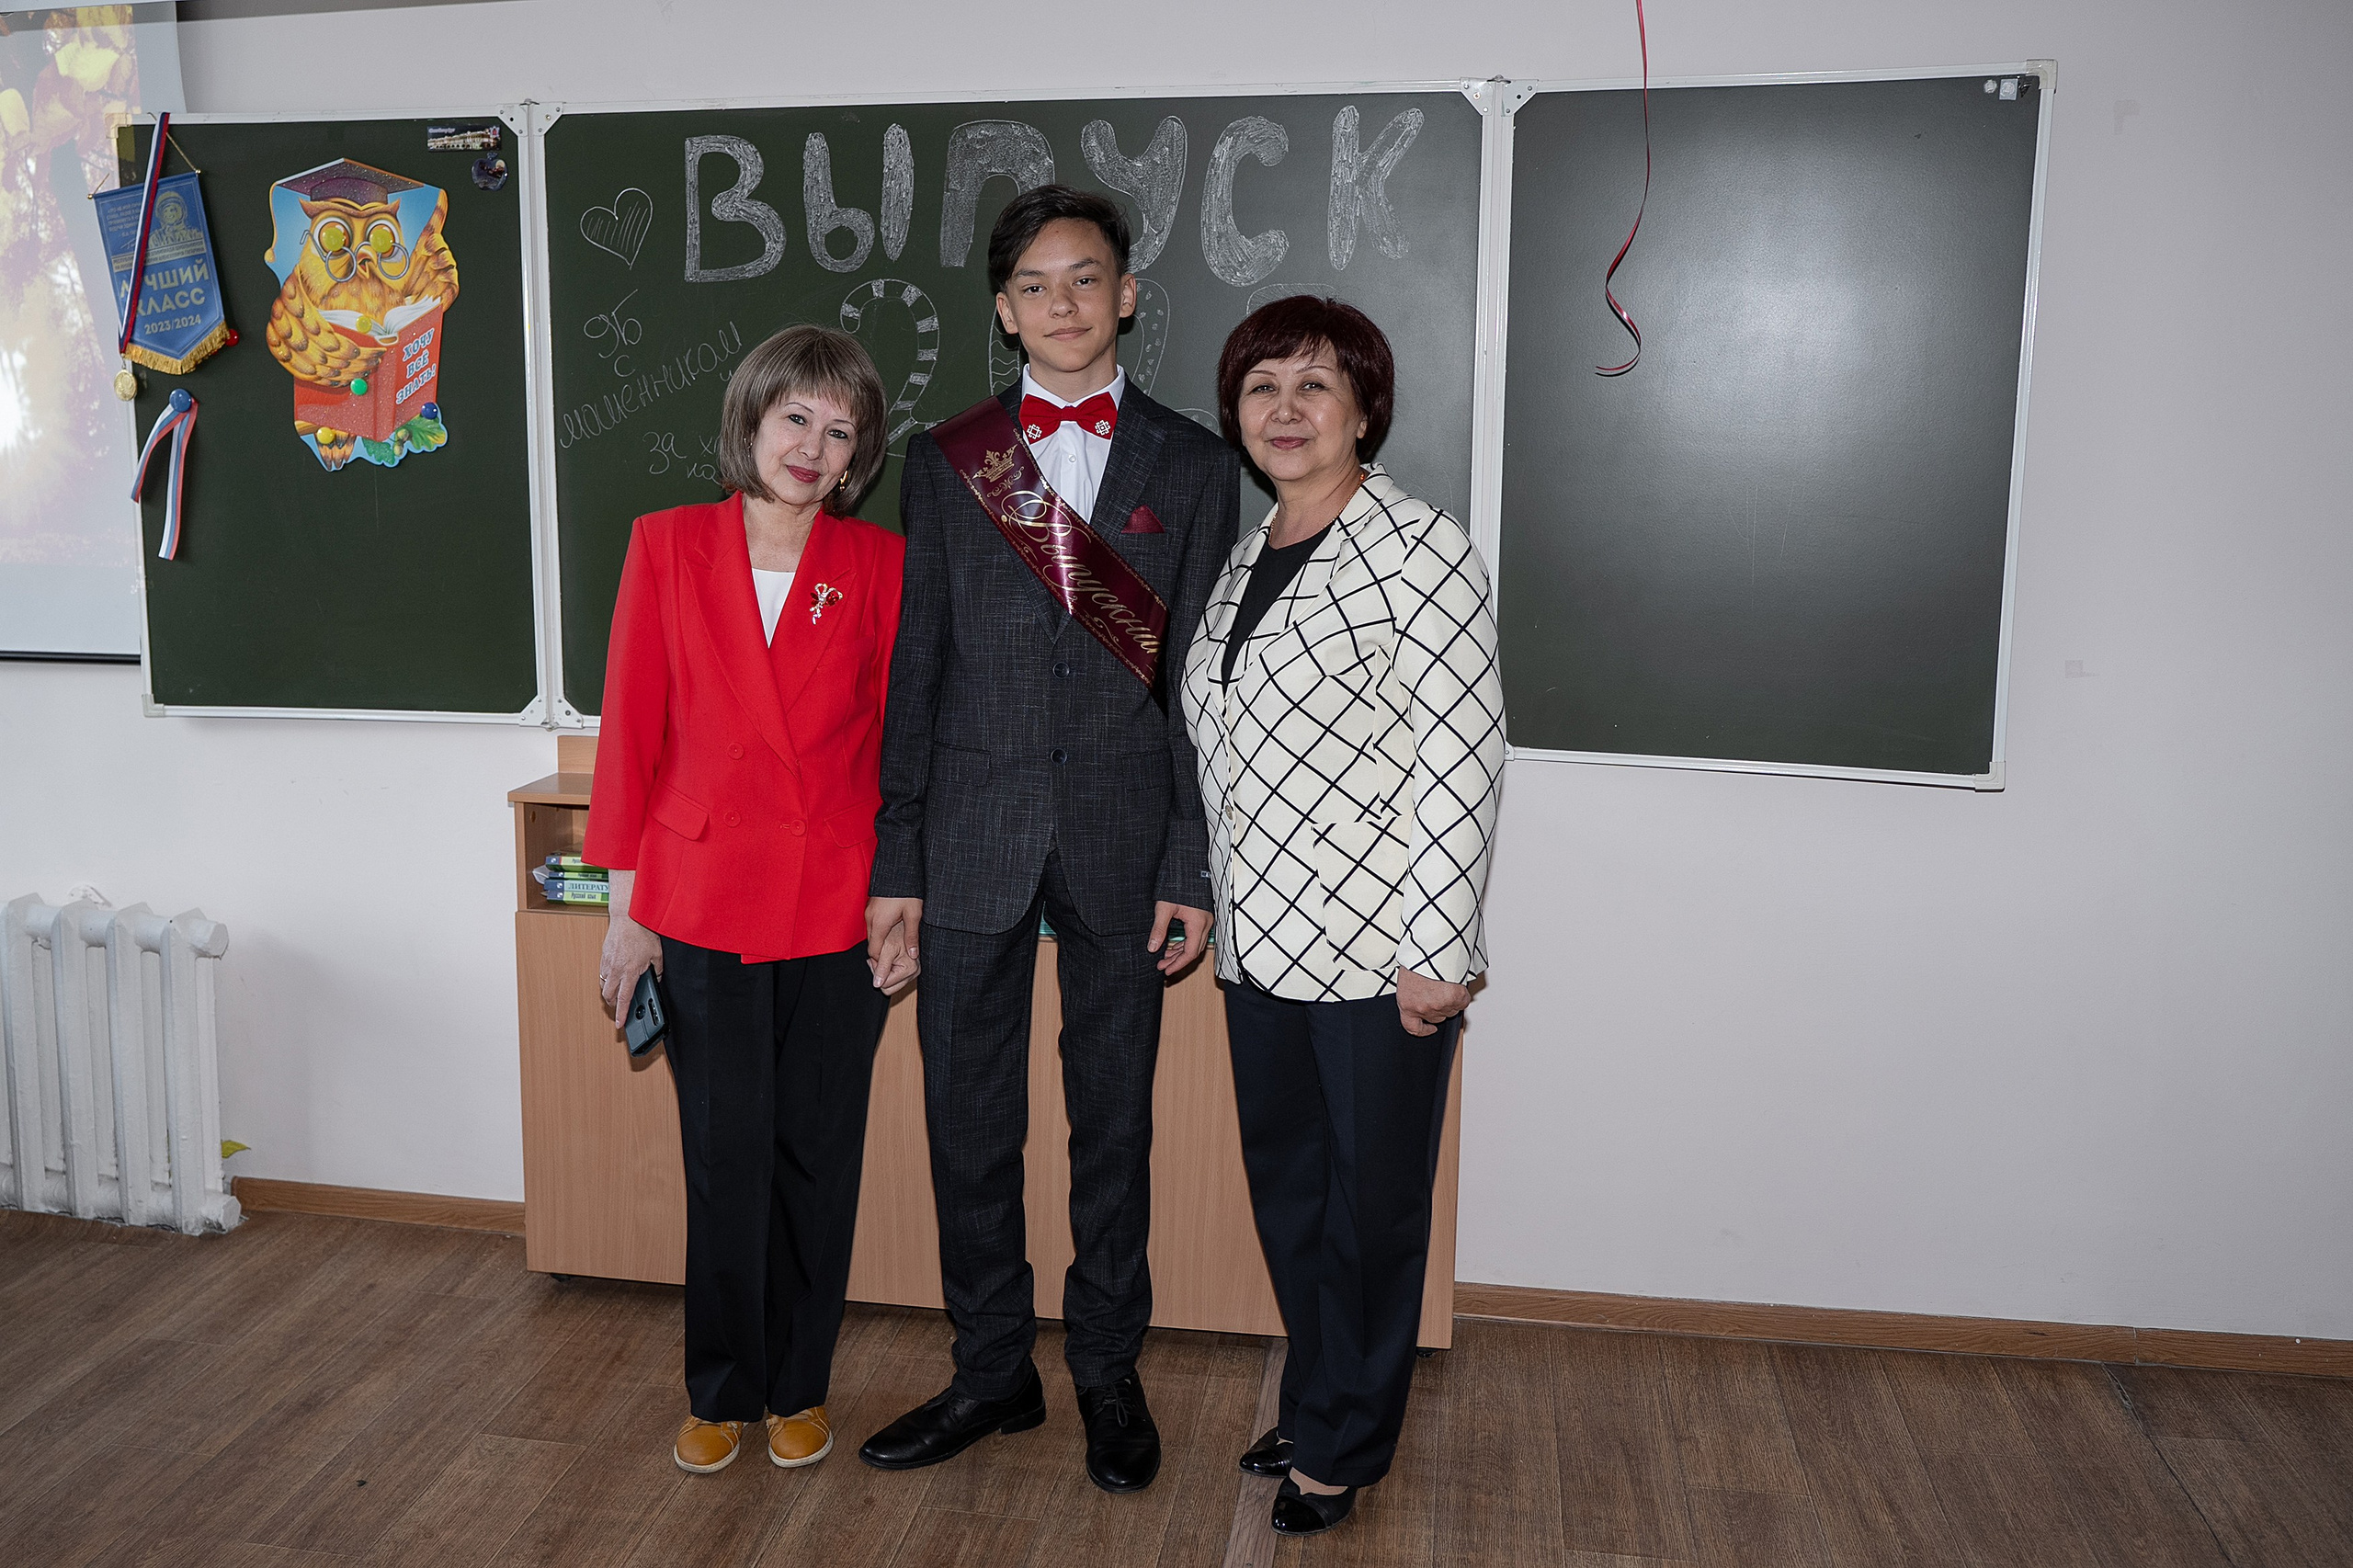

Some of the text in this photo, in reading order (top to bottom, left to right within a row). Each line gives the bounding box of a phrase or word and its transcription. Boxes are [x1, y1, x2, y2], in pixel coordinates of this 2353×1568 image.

[119, 258, 210, 299] ЛЧШИЙ
[143, 313, 201, 335] 2023/2024
[403, 328, 435, 361] ХОЧУ
[395, 363, 437, 404] ЗНАТЬ!
